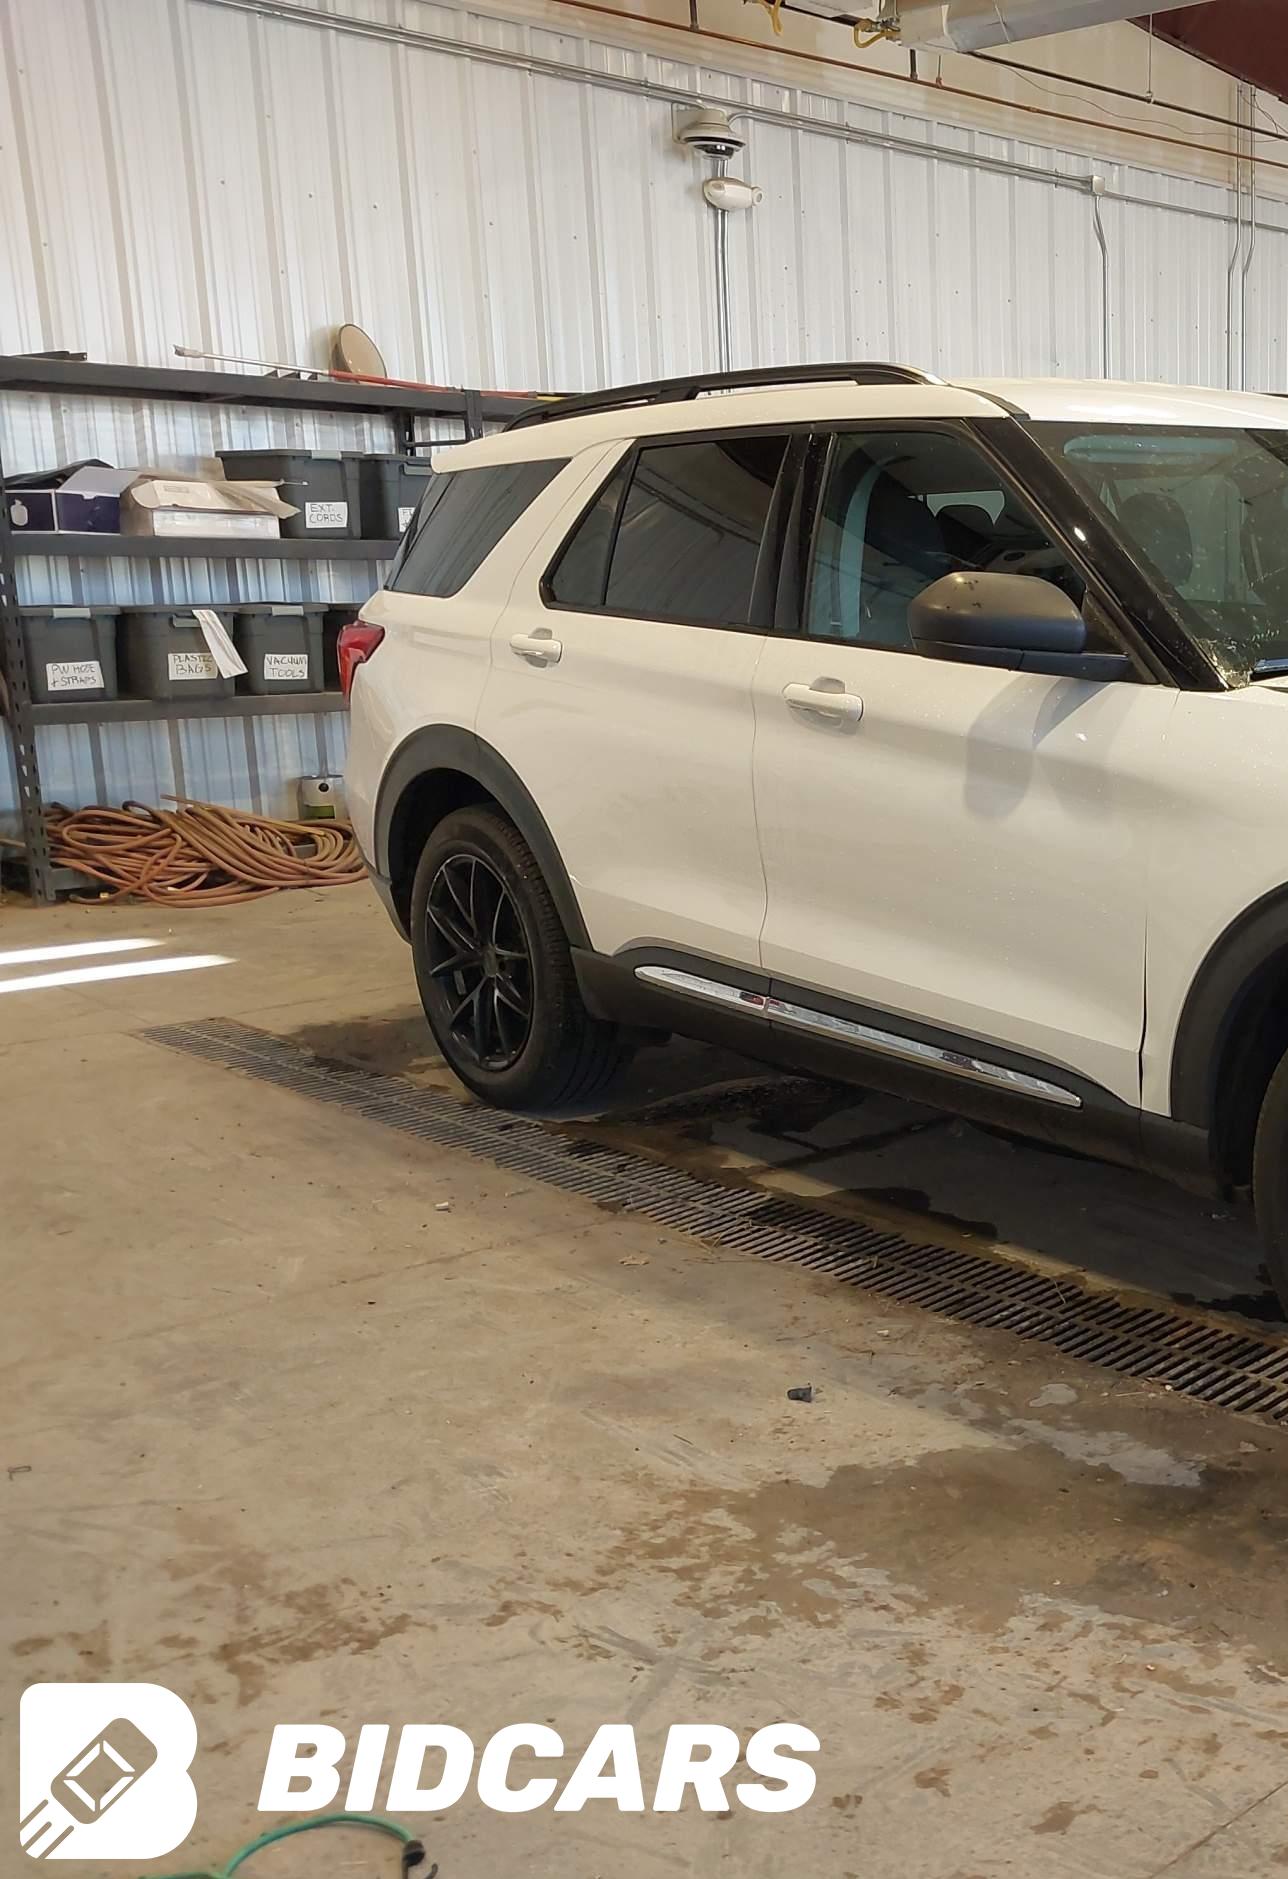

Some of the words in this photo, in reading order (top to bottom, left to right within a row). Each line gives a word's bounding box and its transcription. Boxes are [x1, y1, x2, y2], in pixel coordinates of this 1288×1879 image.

[309, 513, 344, 524] CORDS
[175, 663, 212, 675] BAGS
[268, 667, 305, 678] TOOLS
